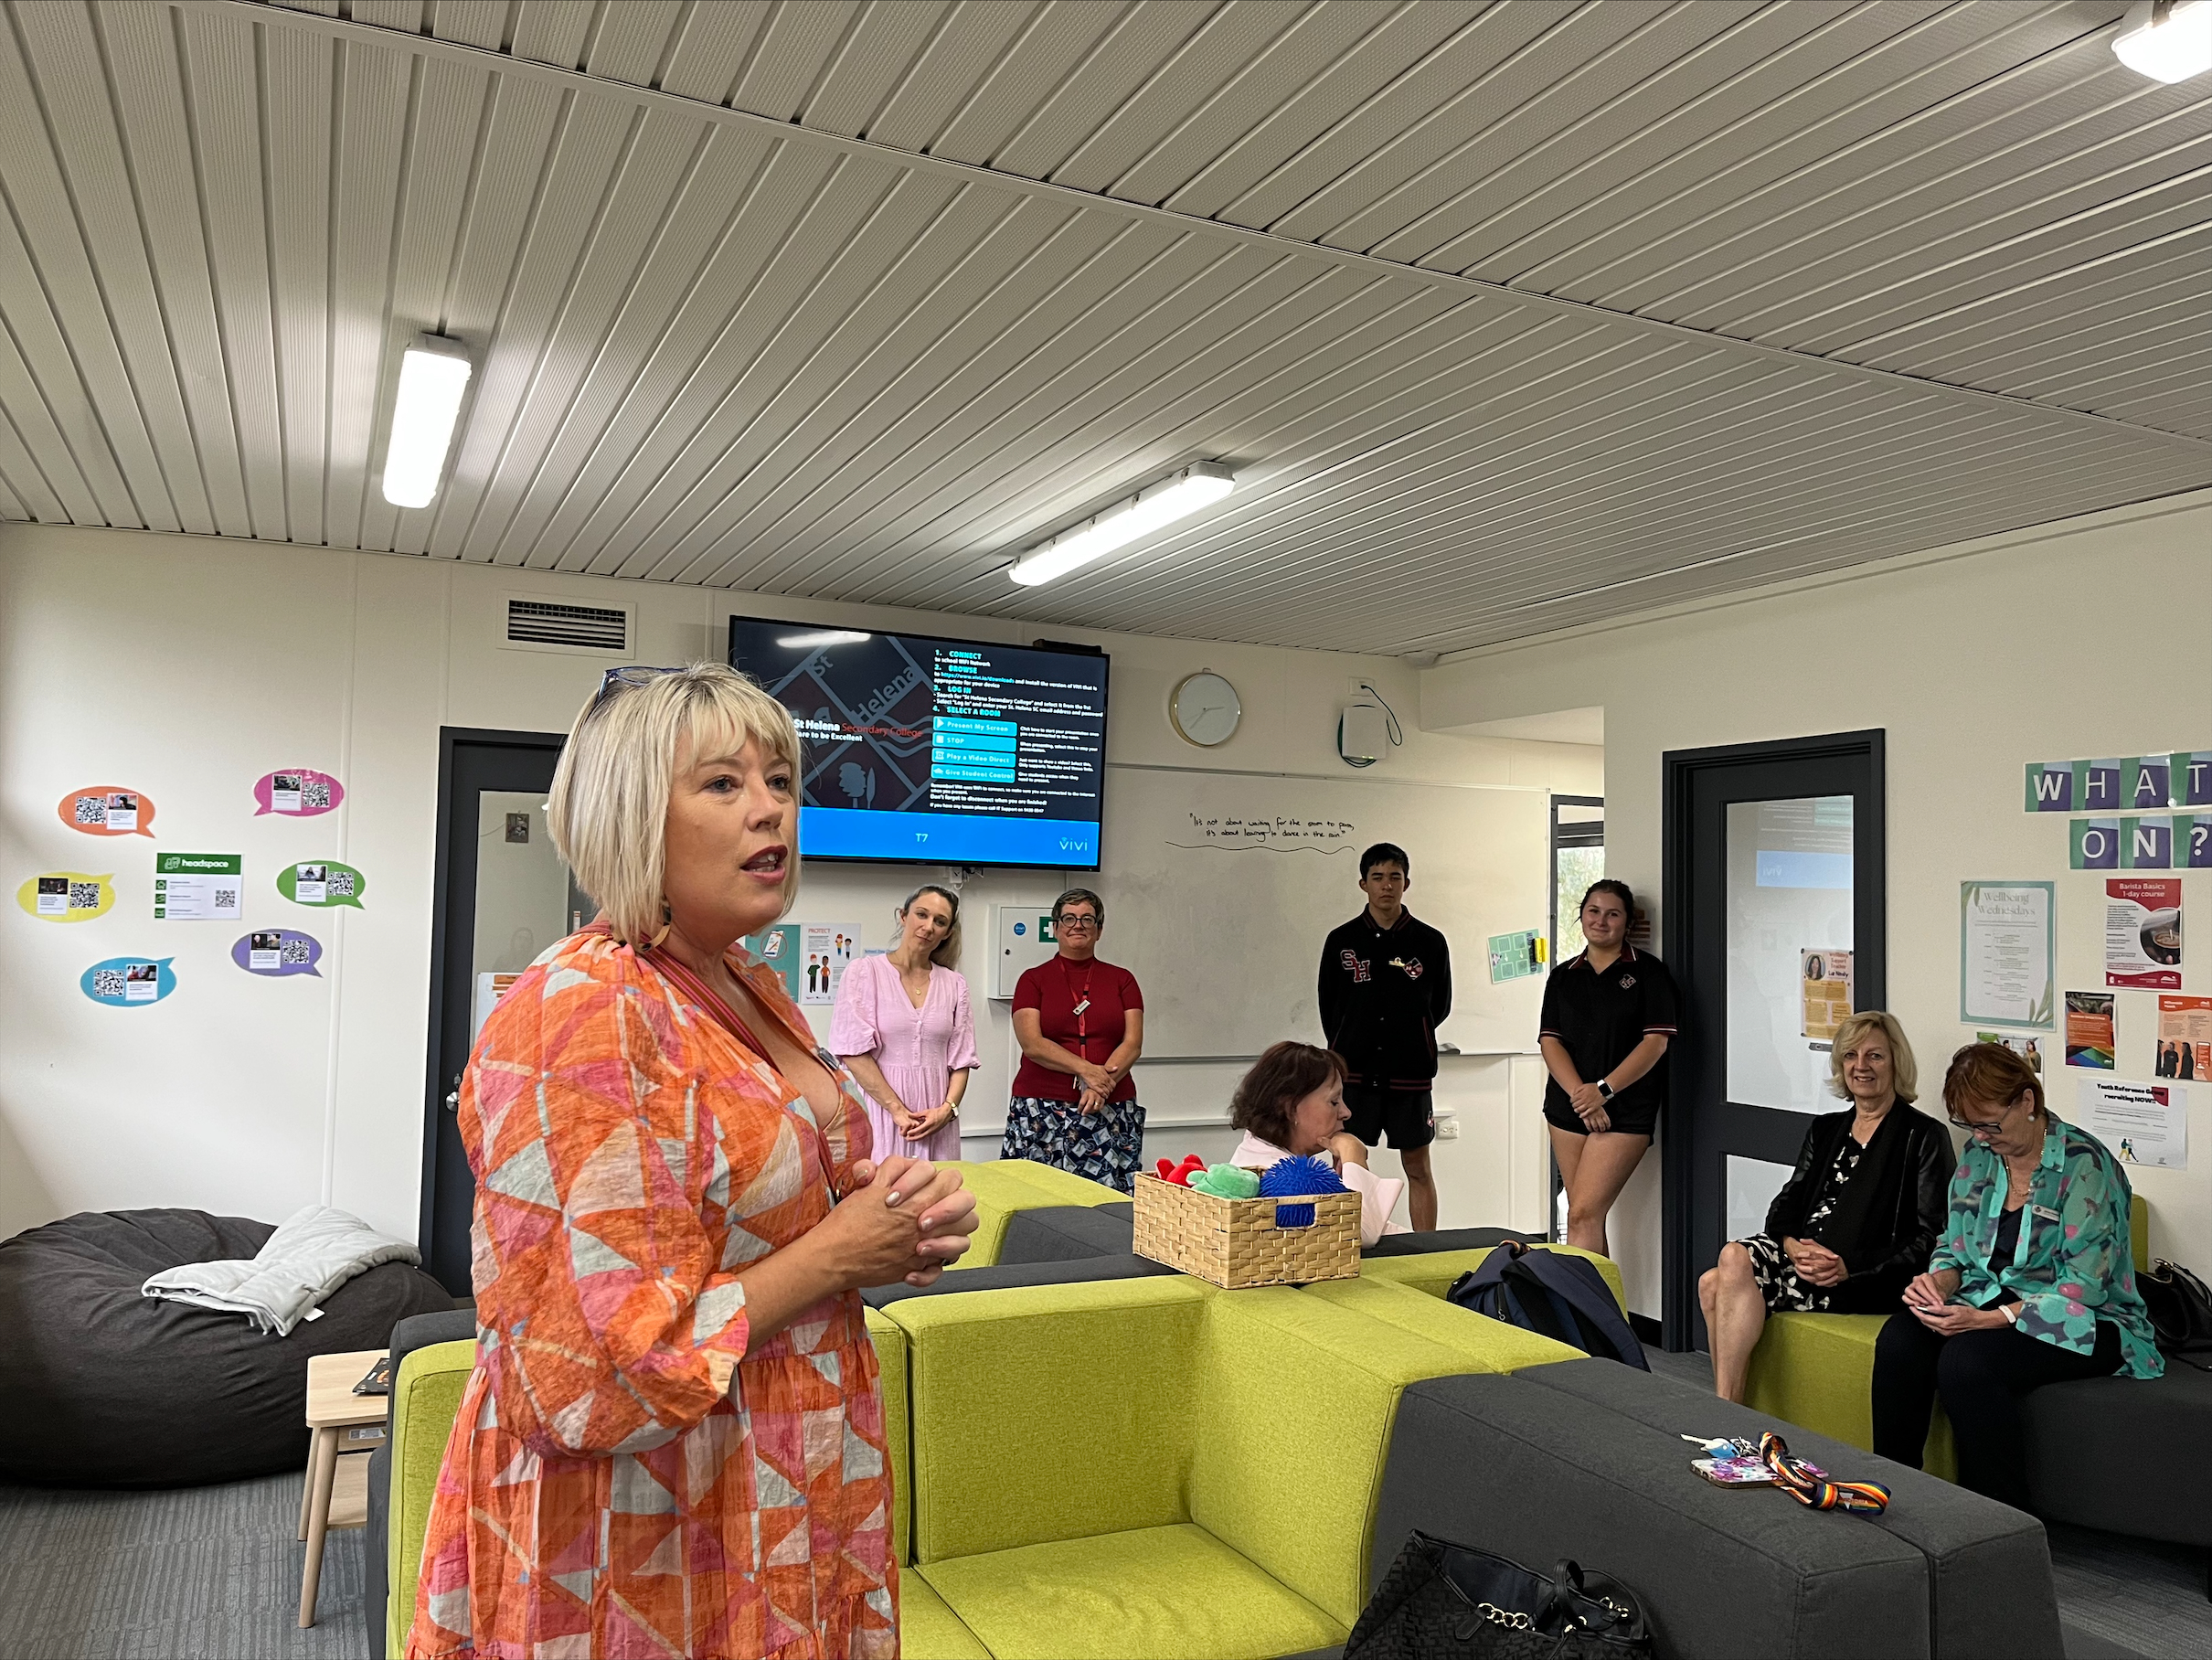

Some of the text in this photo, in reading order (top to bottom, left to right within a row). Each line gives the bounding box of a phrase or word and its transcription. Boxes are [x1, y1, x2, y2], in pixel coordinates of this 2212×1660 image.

[949, 650, 982, 660] CONNECT
[814, 656, 834, 676] St
[949, 665, 977, 674] BROWSE
[850, 665, 915, 723] Helena
[946, 706, 973, 714] SELECT
[793, 718, 923, 739] St Helena Secondary College
[947, 720, 973, 729] Present
[831, 732, 863, 741] Excellent
[2033, 764, 2207, 802] WHAT
[1225, 817, 1242, 825] about
[1248, 819, 1271, 833] waiting
[1276, 817, 1286, 830] for
[915, 833, 929, 843] T7
[1058, 837, 1088, 852] vivi
[182, 859, 229, 868] headspace
[1983, 892, 2029, 905] Wellbeing
[1977, 905, 2036, 917] Wednesdays
[2104, 1094, 2133, 1102] recruiting
